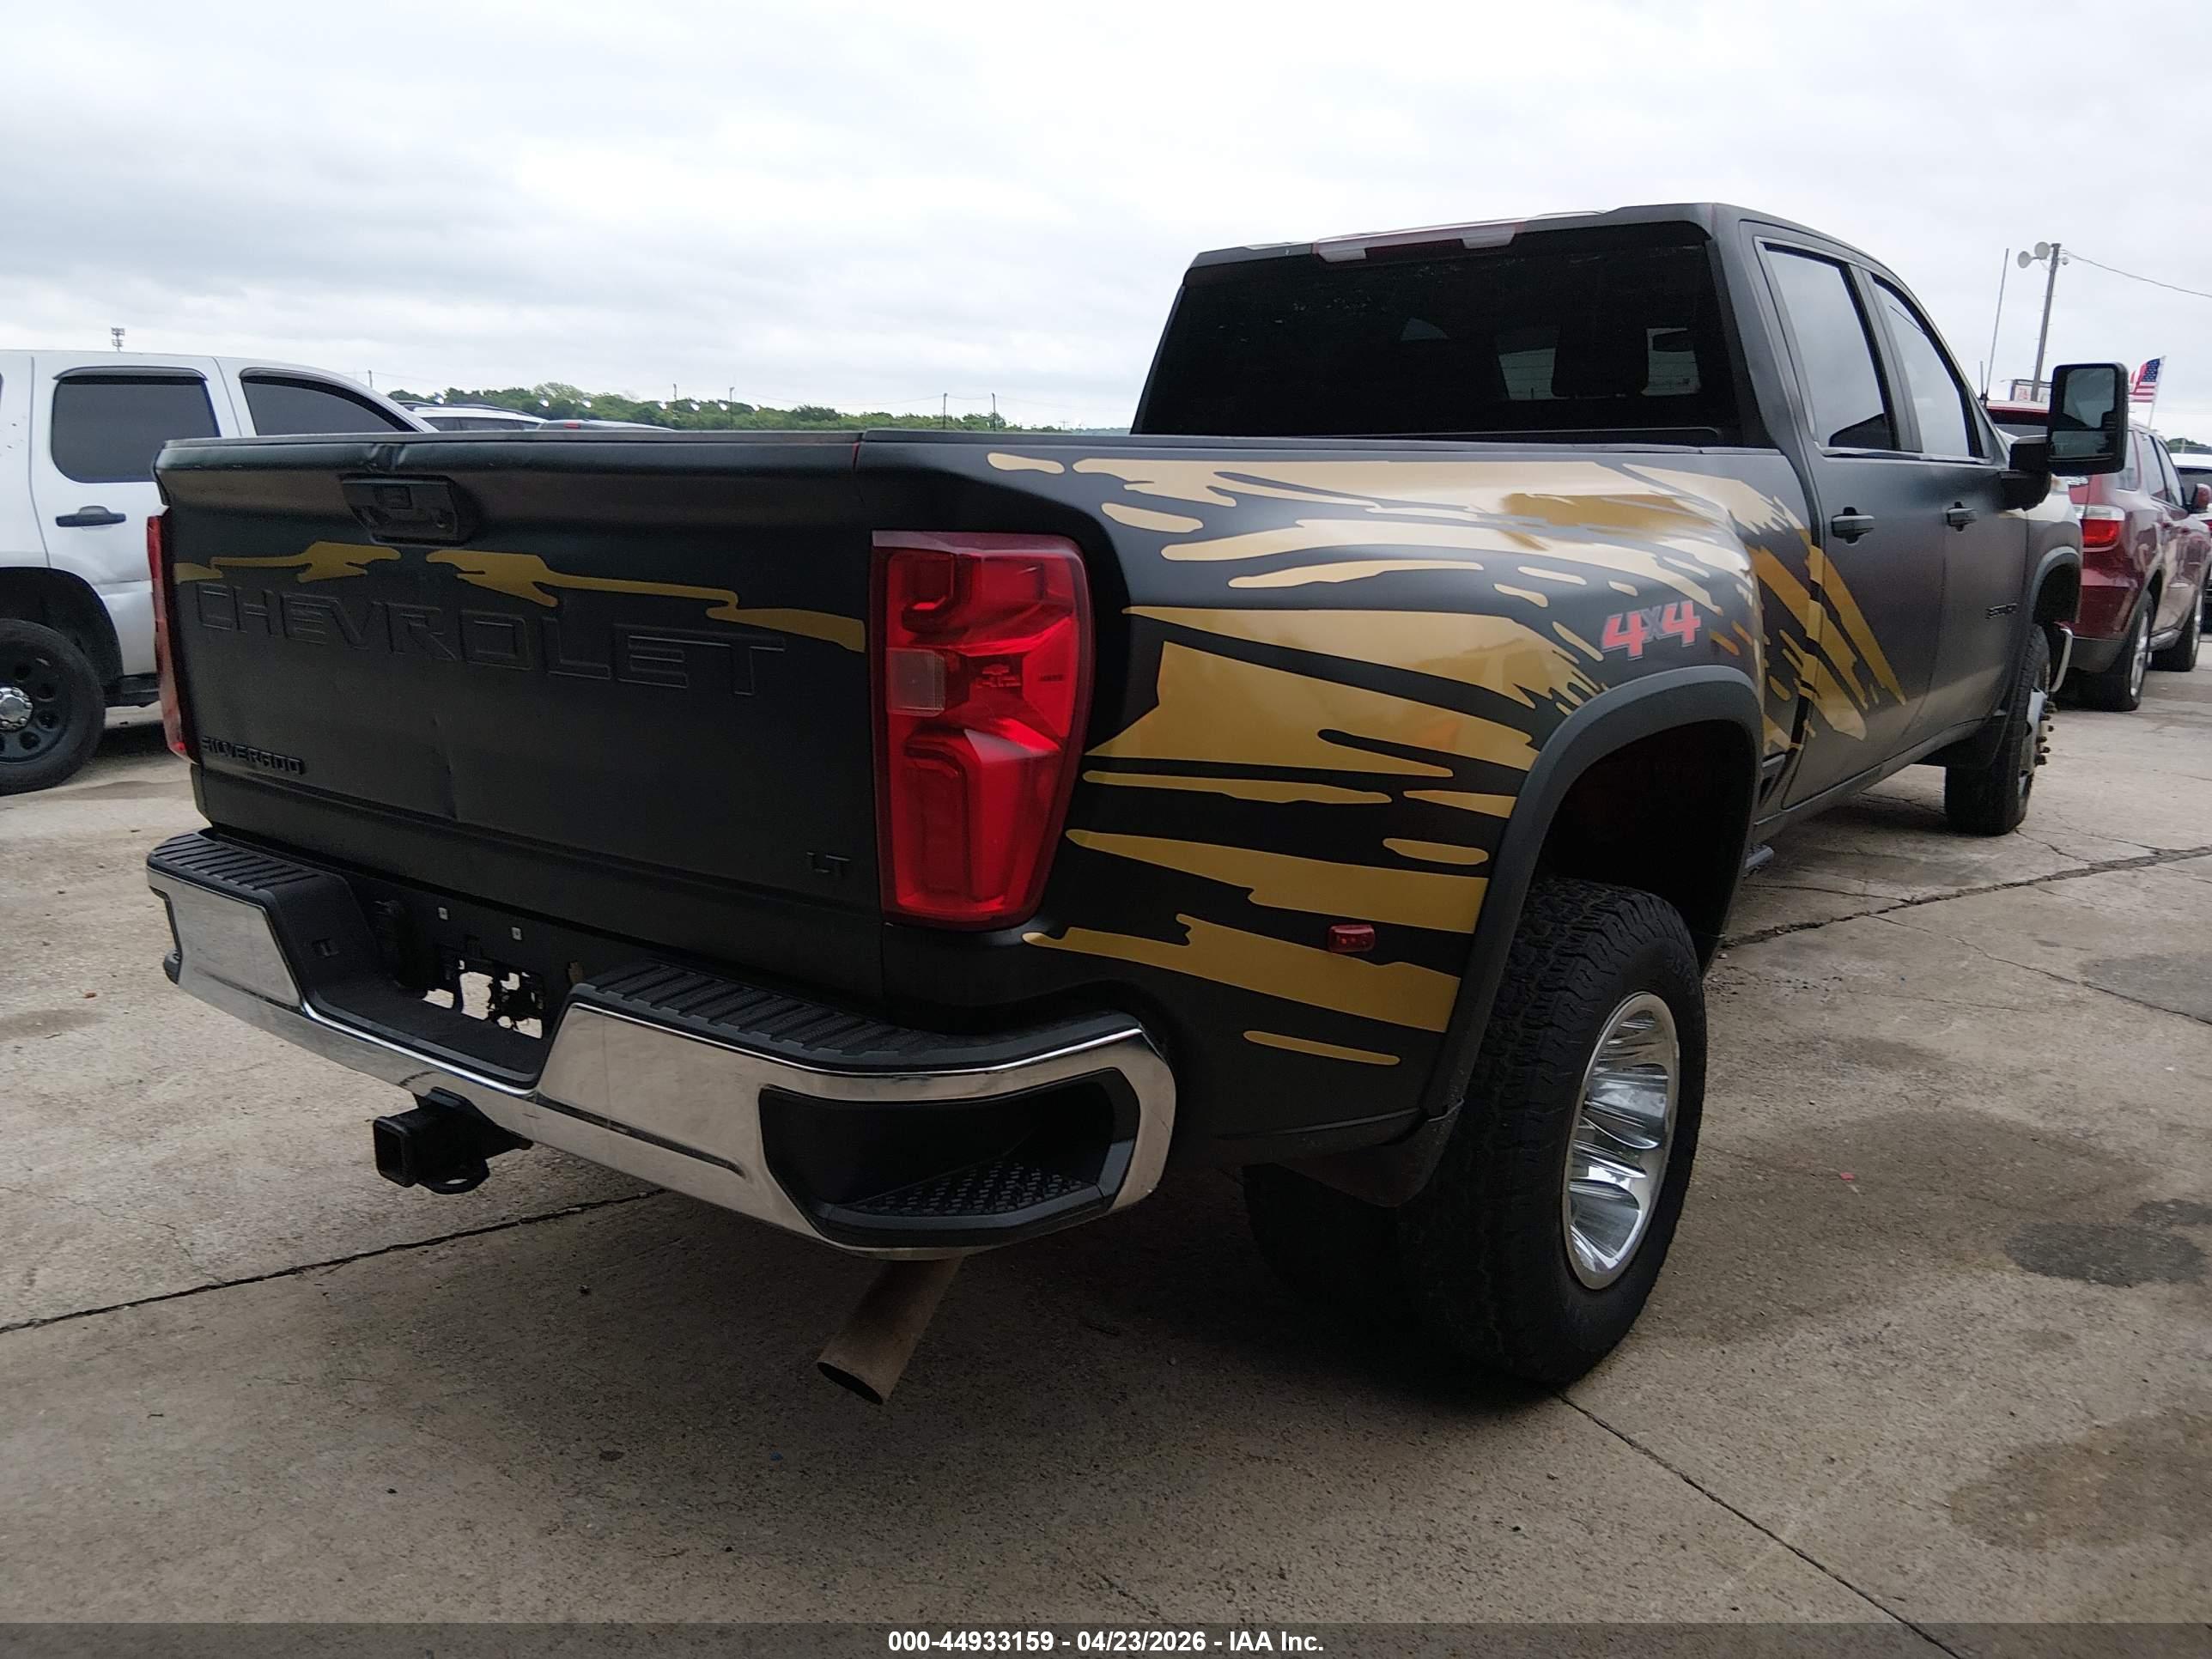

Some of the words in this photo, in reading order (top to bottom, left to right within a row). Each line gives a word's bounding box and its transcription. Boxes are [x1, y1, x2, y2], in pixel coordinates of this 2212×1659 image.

[196, 580, 789, 697] CHEVROLET
[200, 736, 306, 775] SILVERADO
[805, 850, 853, 878] LT
